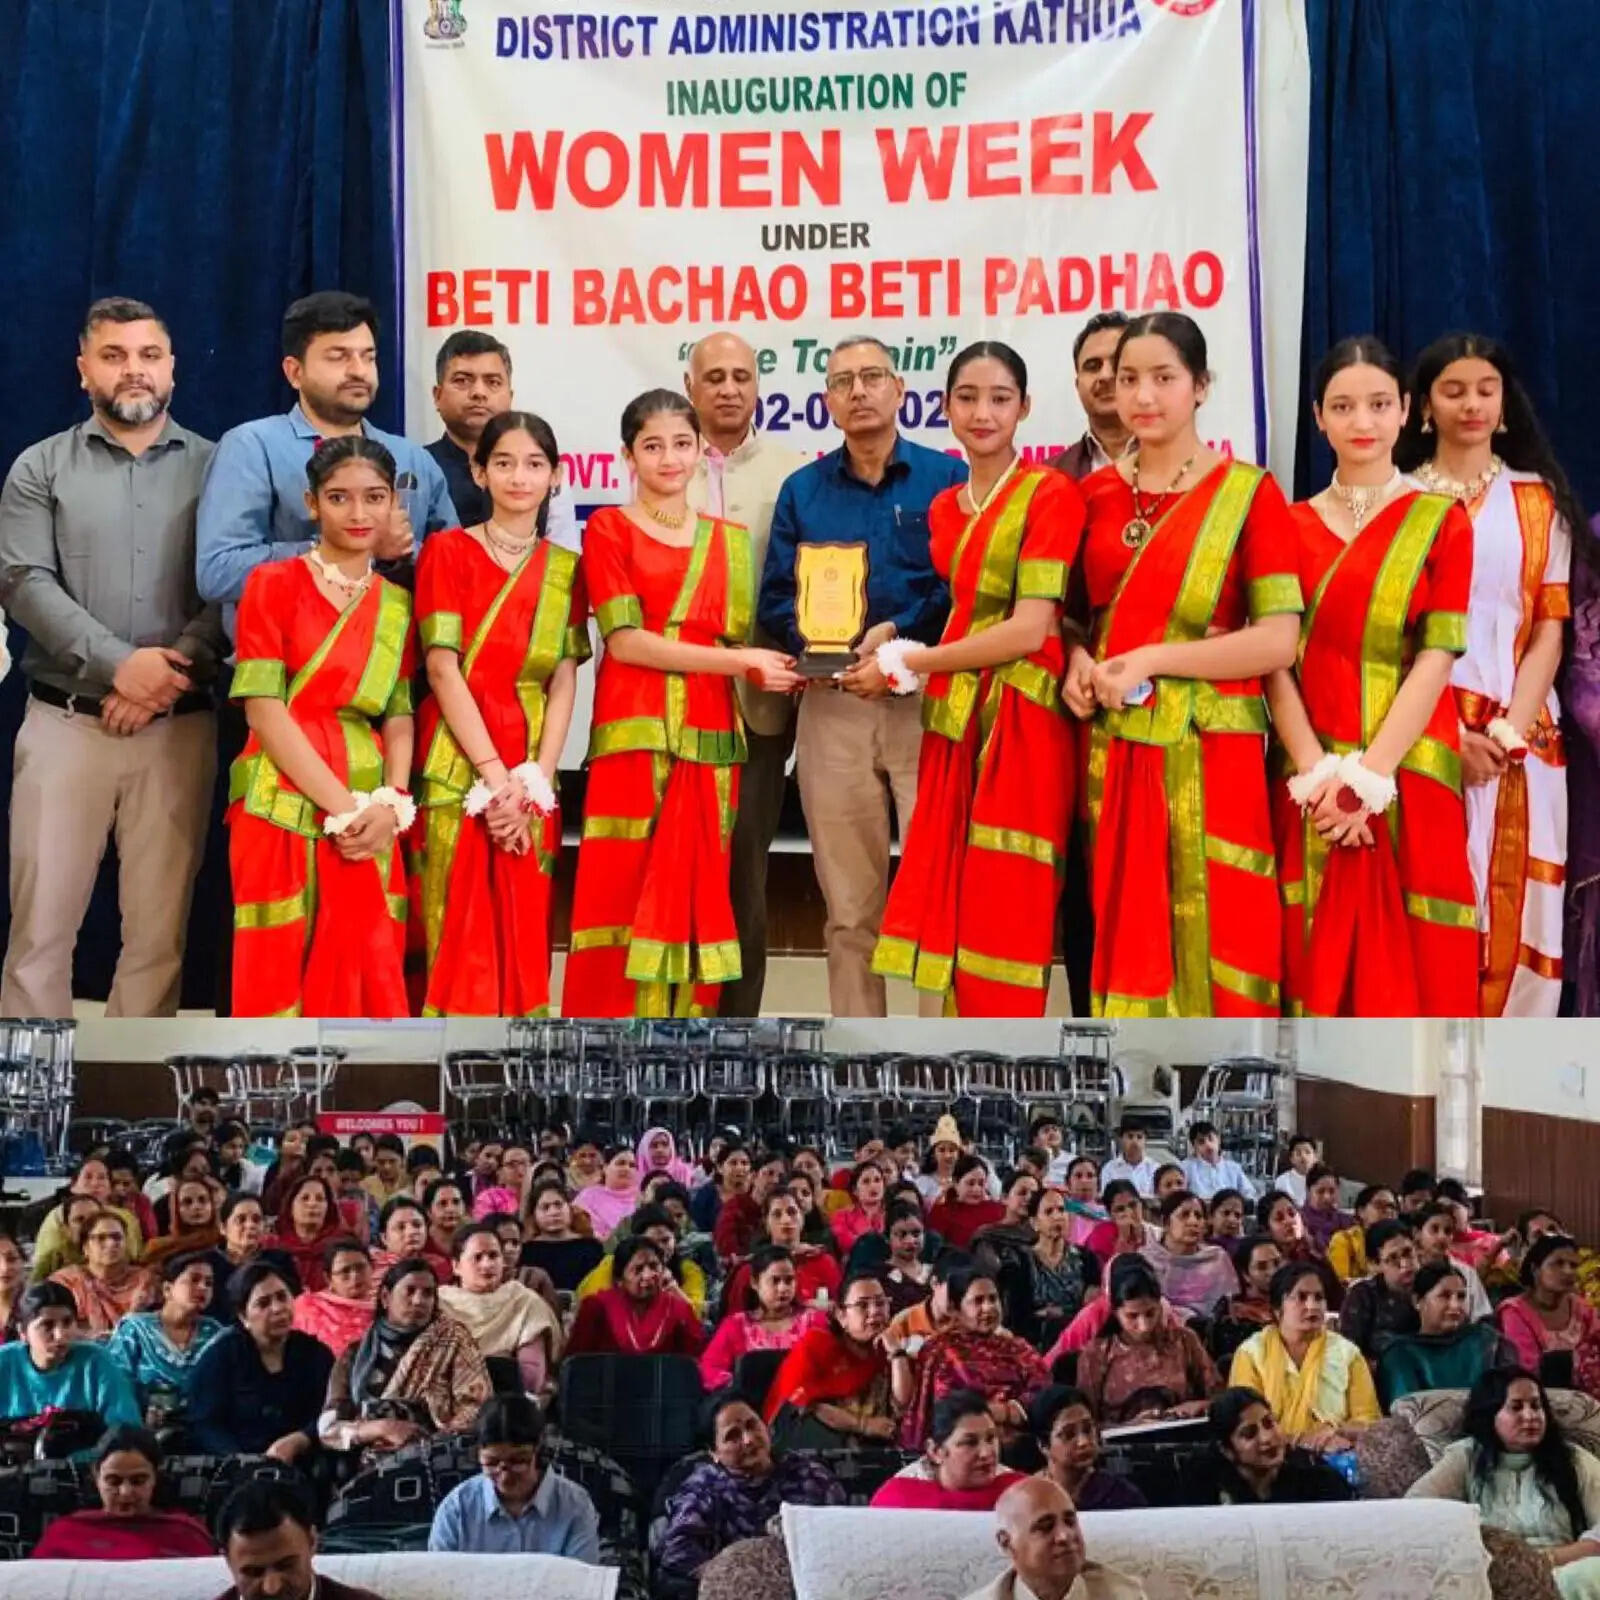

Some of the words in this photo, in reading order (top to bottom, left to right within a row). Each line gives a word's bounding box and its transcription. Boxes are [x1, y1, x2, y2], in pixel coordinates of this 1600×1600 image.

[496, 15, 658, 60] DISTRICT
[668, 6, 980, 55] ADMINISTRATION
[994, 0, 1142, 44] KATHUA
[667, 74, 914, 116] INAUGURATION
[926, 72, 967, 108] OF
[484, 129, 842, 211] WOMEN
[875, 112, 1159, 203] WEEK
[761, 223, 870, 252] UNDER
[426, 268, 550, 328] BETI
[573, 264, 808, 326] BACHAO
[830, 258, 961, 319] BETI
[984, 250, 1224, 315] PADHAO
[558, 452, 619, 489] OVT.
